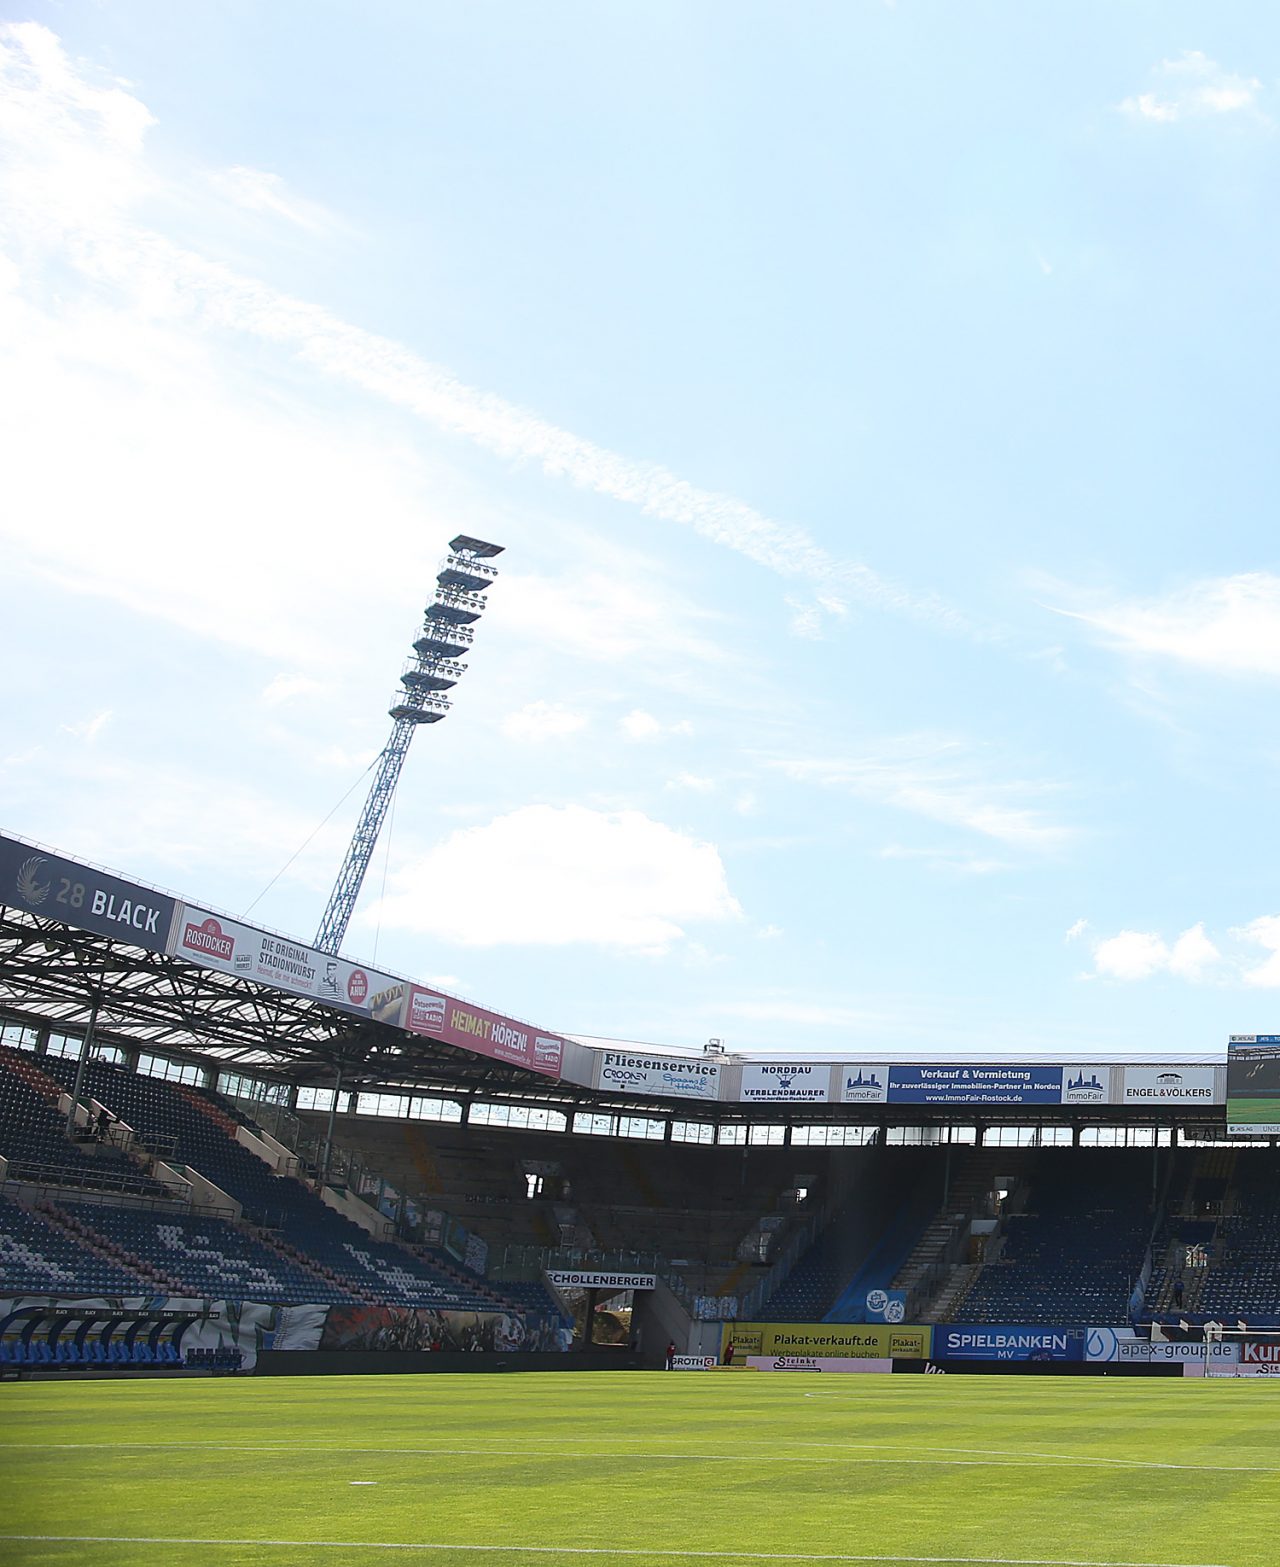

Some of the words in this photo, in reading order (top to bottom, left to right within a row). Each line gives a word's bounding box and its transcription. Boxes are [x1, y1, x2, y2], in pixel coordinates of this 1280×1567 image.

[56, 878, 86, 908] 28
[91, 889, 161, 934] BLACK
[185, 928, 231, 956] ROSTOCKER
[261, 938, 275, 952] DIE
[275, 942, 309, 964] ORIGINAL
[258, 951, 316, 980] STADIONWURST
[425, 1013, 443, 1023] RADIO
[450, 1009, 492, 1040] HEIMAT
[491, 1021, 529, 1052] HÖREN!
[604, 1053, 718, 1076] Fliesenservice
[761, 1066, 812, 1075] NORDBAU
[920, 1069, 960, 1080] Verkauf
[962, 1069, 970, 1079] &
[972, 1069, 1031, 1081] Vermietung
[889, 1082, 900, 1090] Ihr
[901, 1082, 950, 1091] zuverlässiger
[1033, 1082, 1061, 1091] Norden
[744, 1089, 825, 1097] VERBLENDMAURER
[845, 1090, 882, 1099] ImmoFair
[1066, 1090, 1103, 1100] ImmoFair
[774, 1334, 878, 1347] Plakat-verkauft.de
[947, 1333, 1067, 1350] SPIELBANKEN
[770, 1350, 824, 1358] Werbeplakate
[824, 1350, 848, 1358] online
[997, 1351, 1014, 1359] MV
[1121, 1343, 1231, 1359] apex-group.de
[777, 1357, 817, 1368] Steinke
